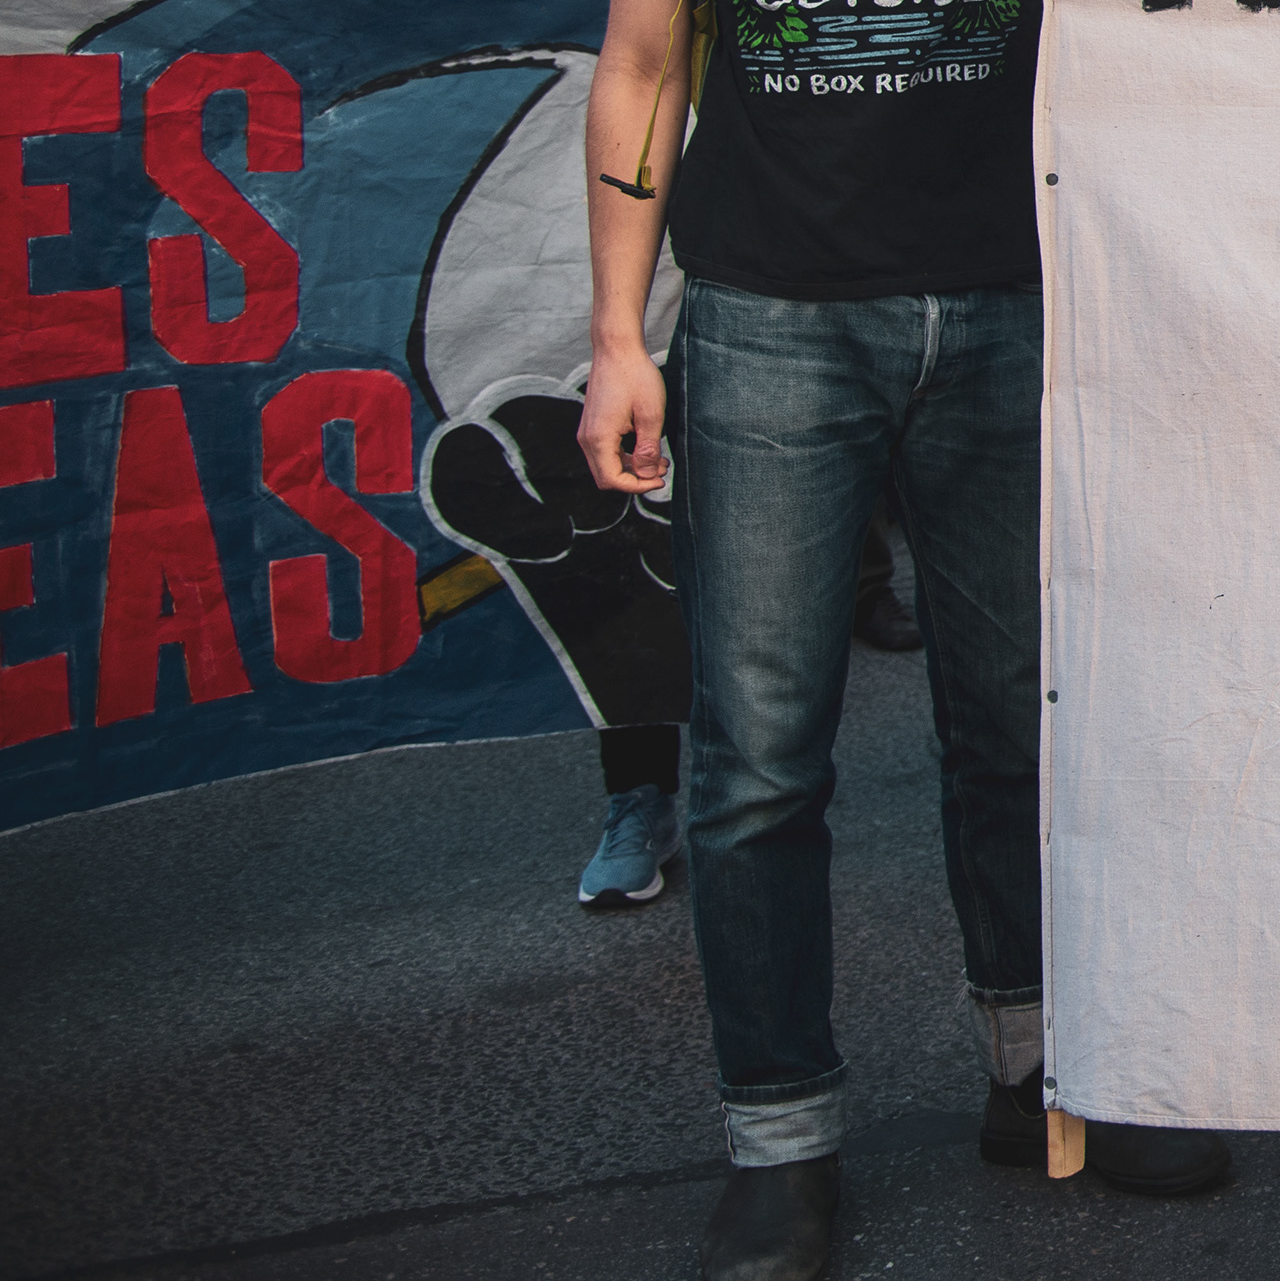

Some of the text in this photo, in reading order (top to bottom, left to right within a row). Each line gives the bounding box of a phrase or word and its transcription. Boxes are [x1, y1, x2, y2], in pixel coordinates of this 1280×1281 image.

[764, 63, 990, 95] NO BOX REQUIRED
